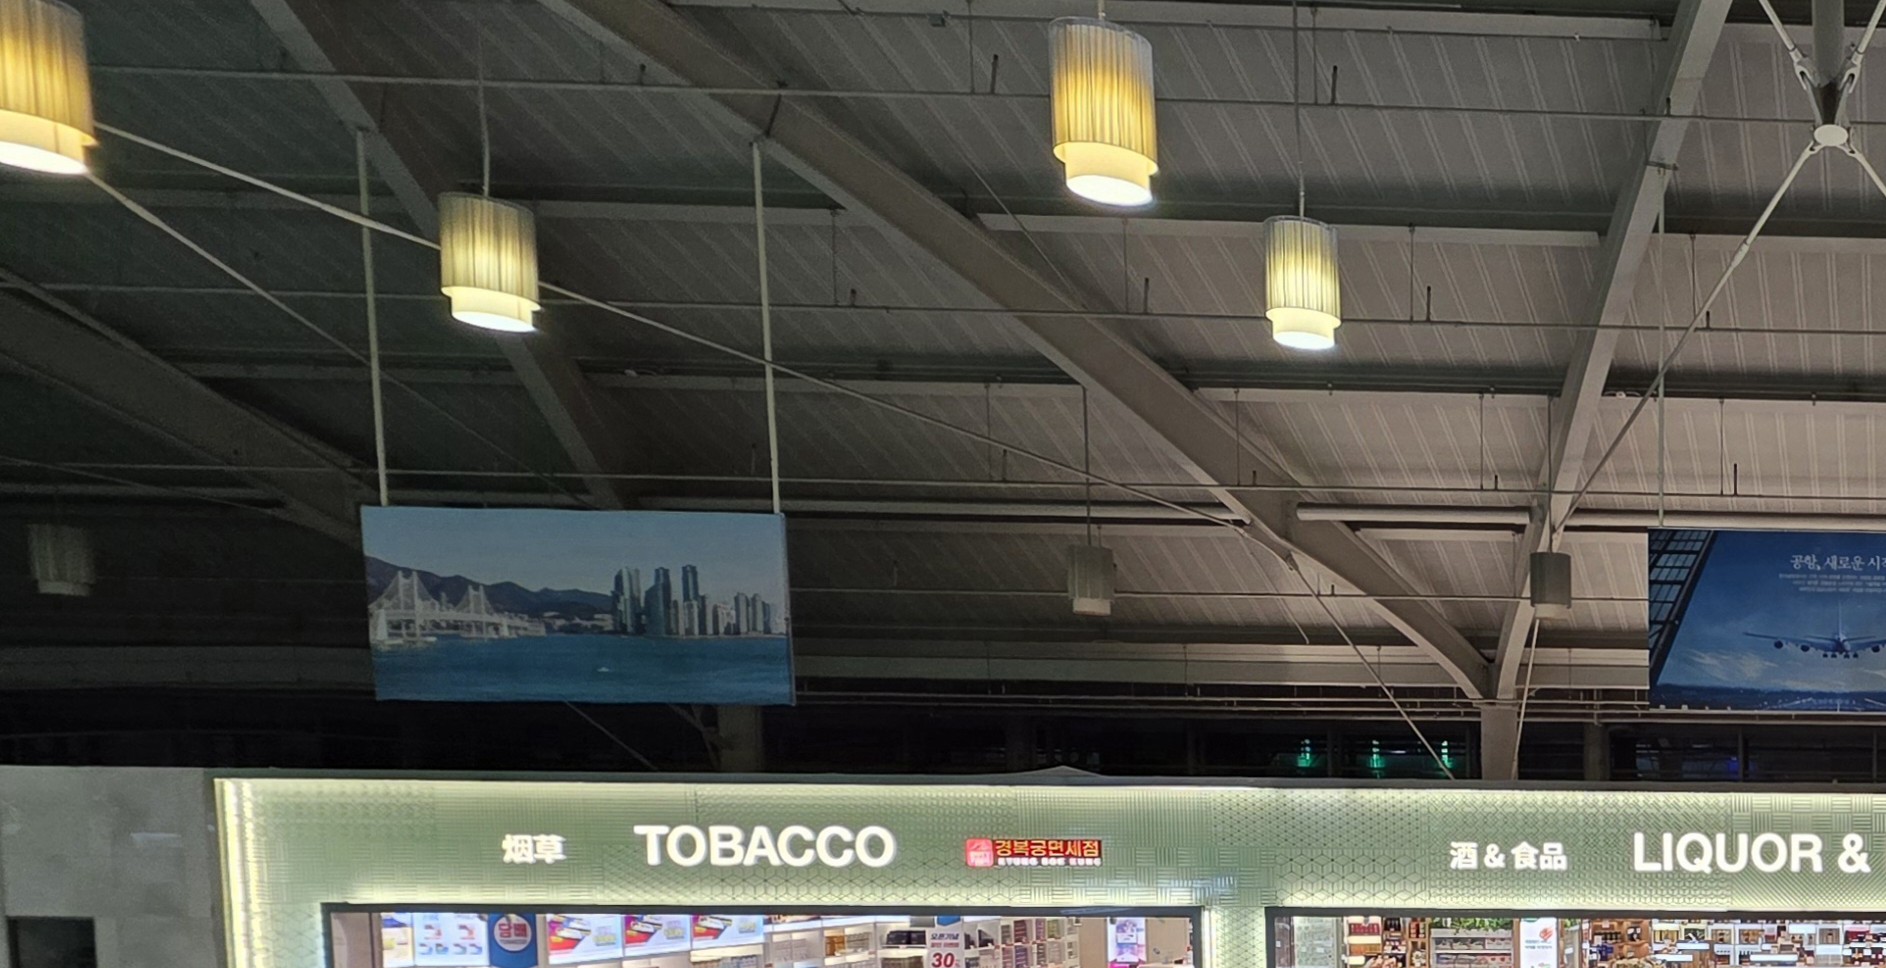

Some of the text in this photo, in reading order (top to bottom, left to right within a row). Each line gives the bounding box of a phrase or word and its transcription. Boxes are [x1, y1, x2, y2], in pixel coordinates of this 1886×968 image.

[1790, 554, 1821, 571] 공항,
[1824, 555, 1865, 571] 새로운
[501, 833, 566, 864] 烟草
[633, 825, 896, 868] TOBACCO
[995, 839, 1100, 857] 경복궁면세점
[1449, 841, 1568, 870] 酒 & 食品
[1634, 832, 1823, 874] LIQUOR
[1837, 833, 1871, 873] &
[931, 952, 955, 968] 30
